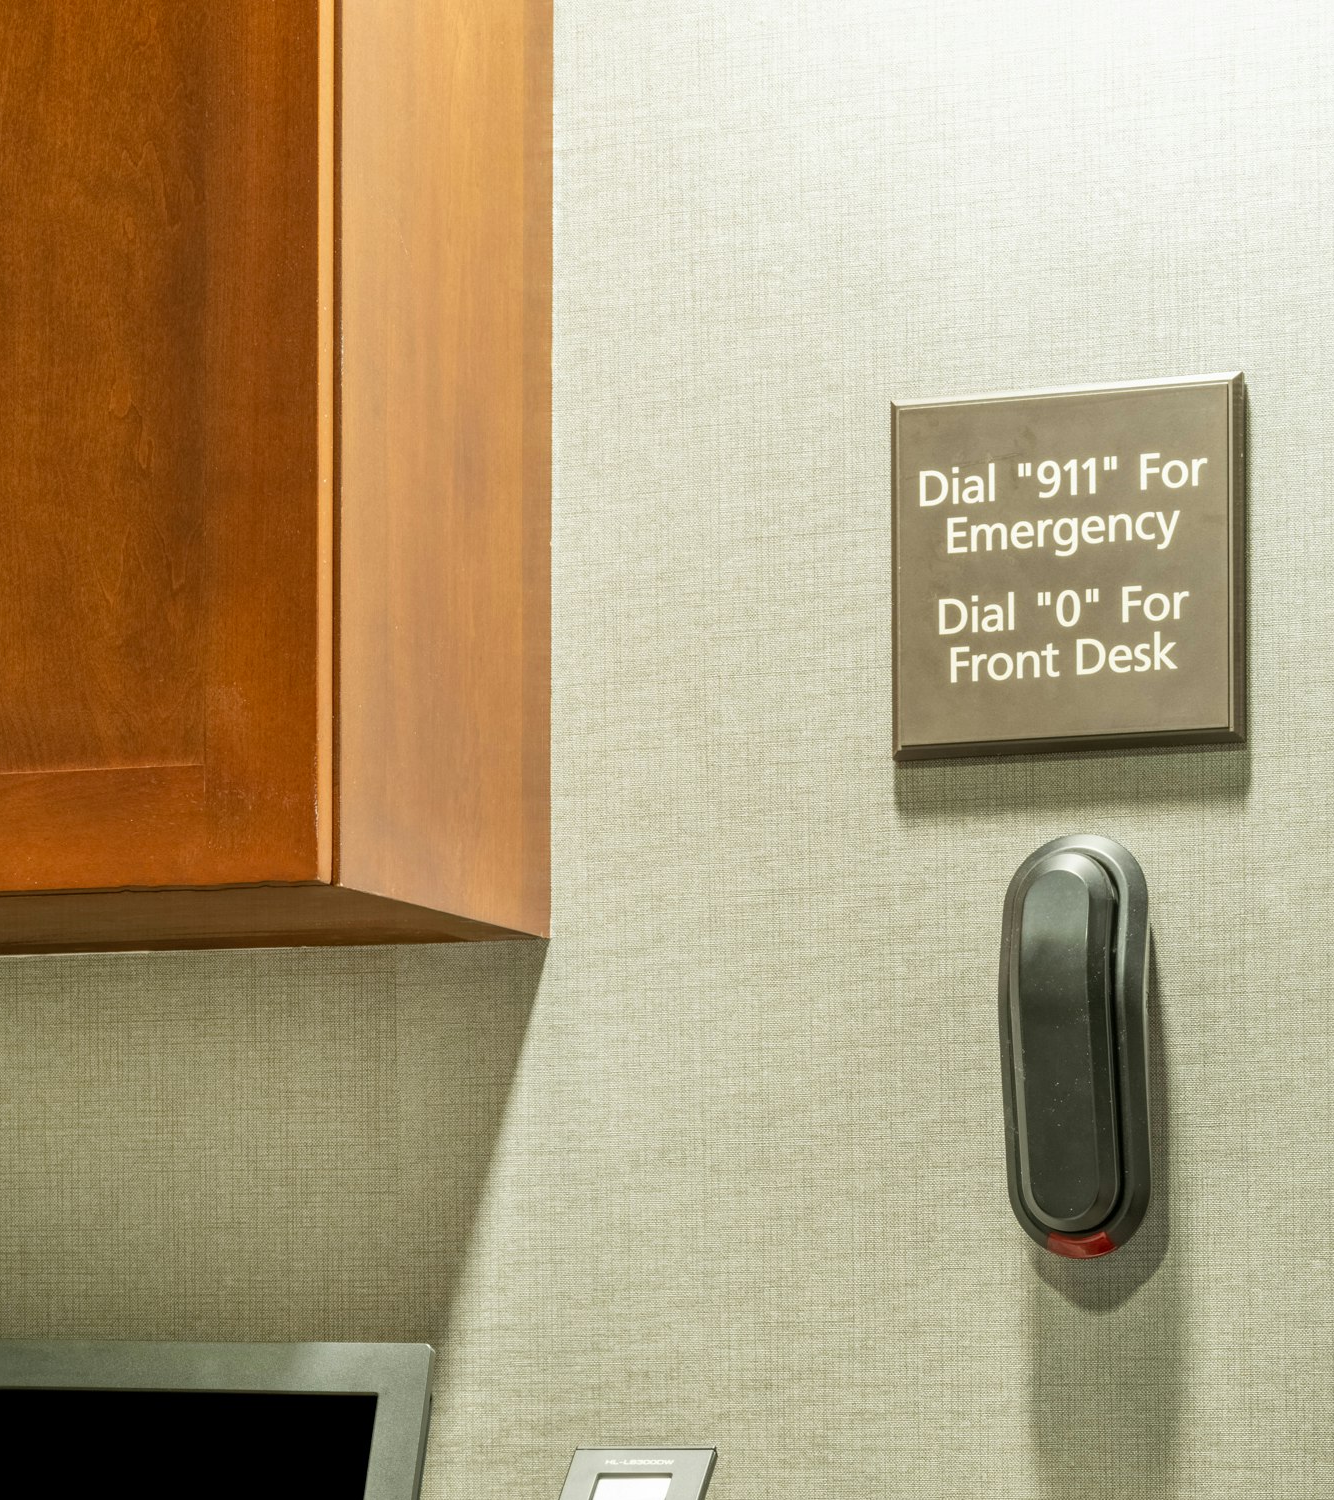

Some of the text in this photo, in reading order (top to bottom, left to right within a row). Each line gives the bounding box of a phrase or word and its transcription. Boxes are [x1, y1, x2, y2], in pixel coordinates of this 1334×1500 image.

[918, 452, 1209, 508] Dial "911" For
[946, 509, 1181, 558] Emergency
[938, 584, 1190, 636] Dial "0" For
[949, 630, 1179, 684] Front Desk
